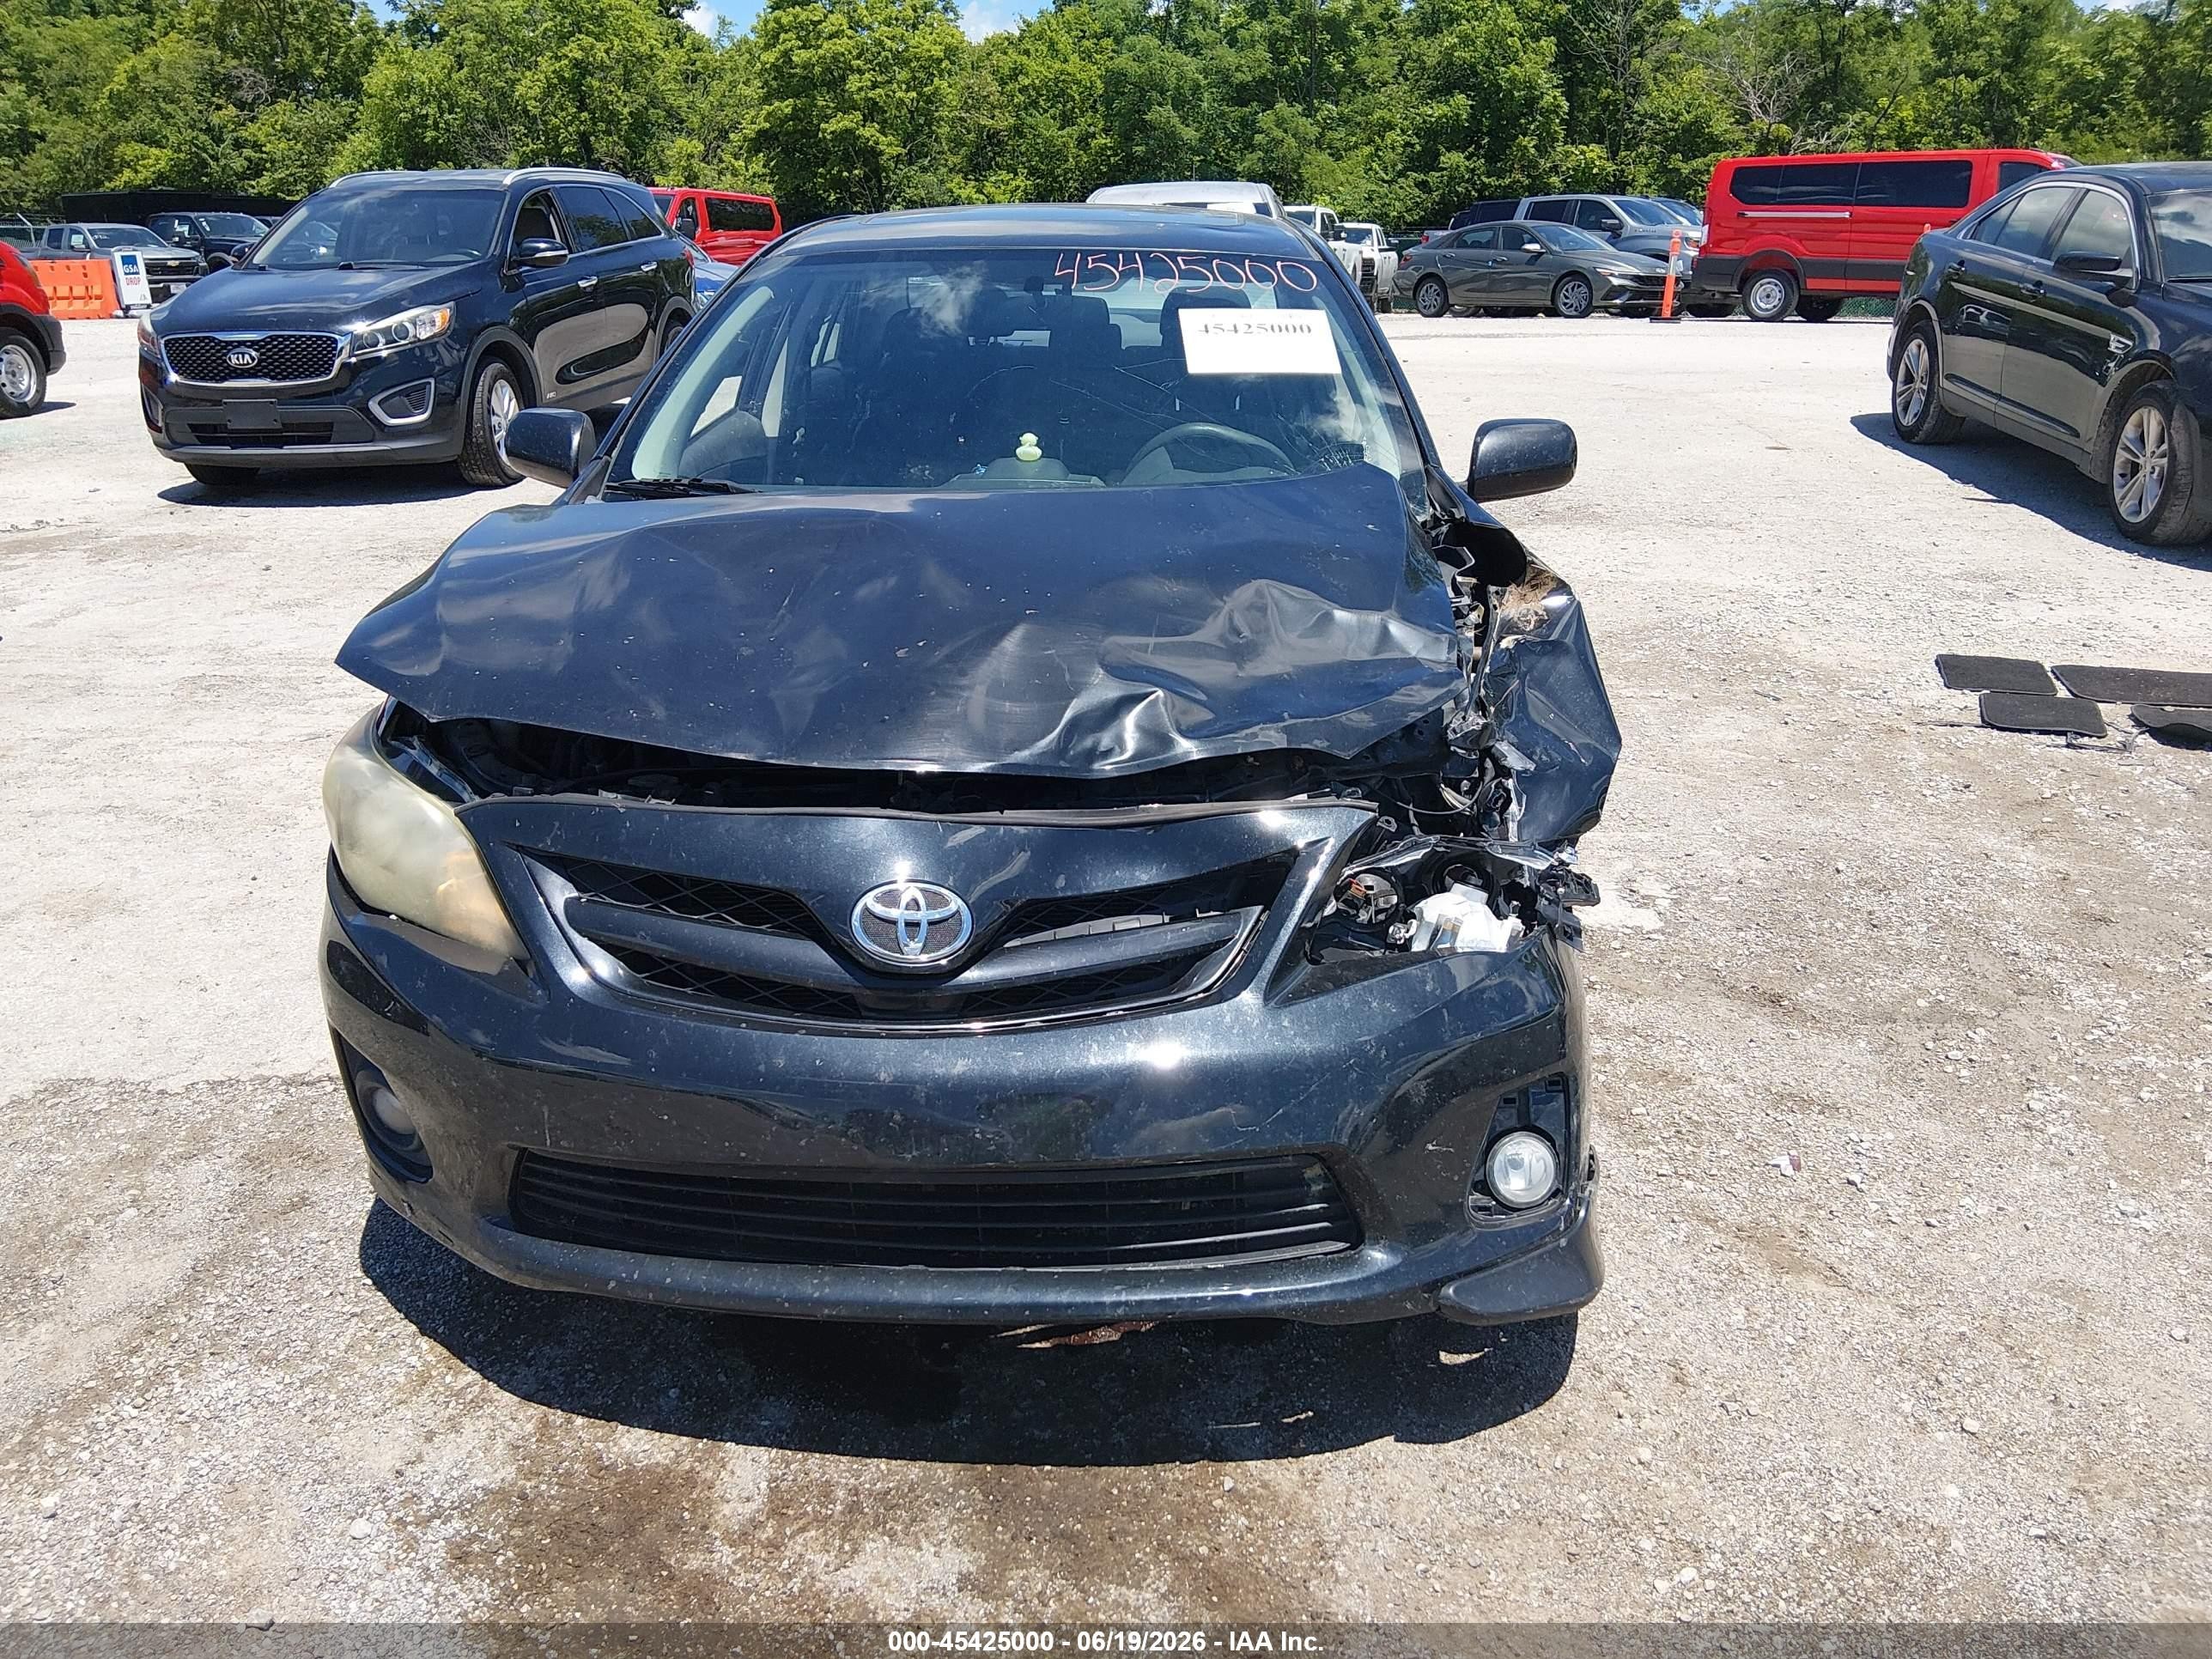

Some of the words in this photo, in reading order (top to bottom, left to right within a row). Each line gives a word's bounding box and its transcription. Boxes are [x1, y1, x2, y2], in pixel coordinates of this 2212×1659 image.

[123, 264, 139, 273] GSA
[1054, 252, 1317, 293] 45425000
[125, 276, 141, 286] DROP
[1198, 322, 1312, 335] 45425000
[230, 353, 252, 365] KIA
